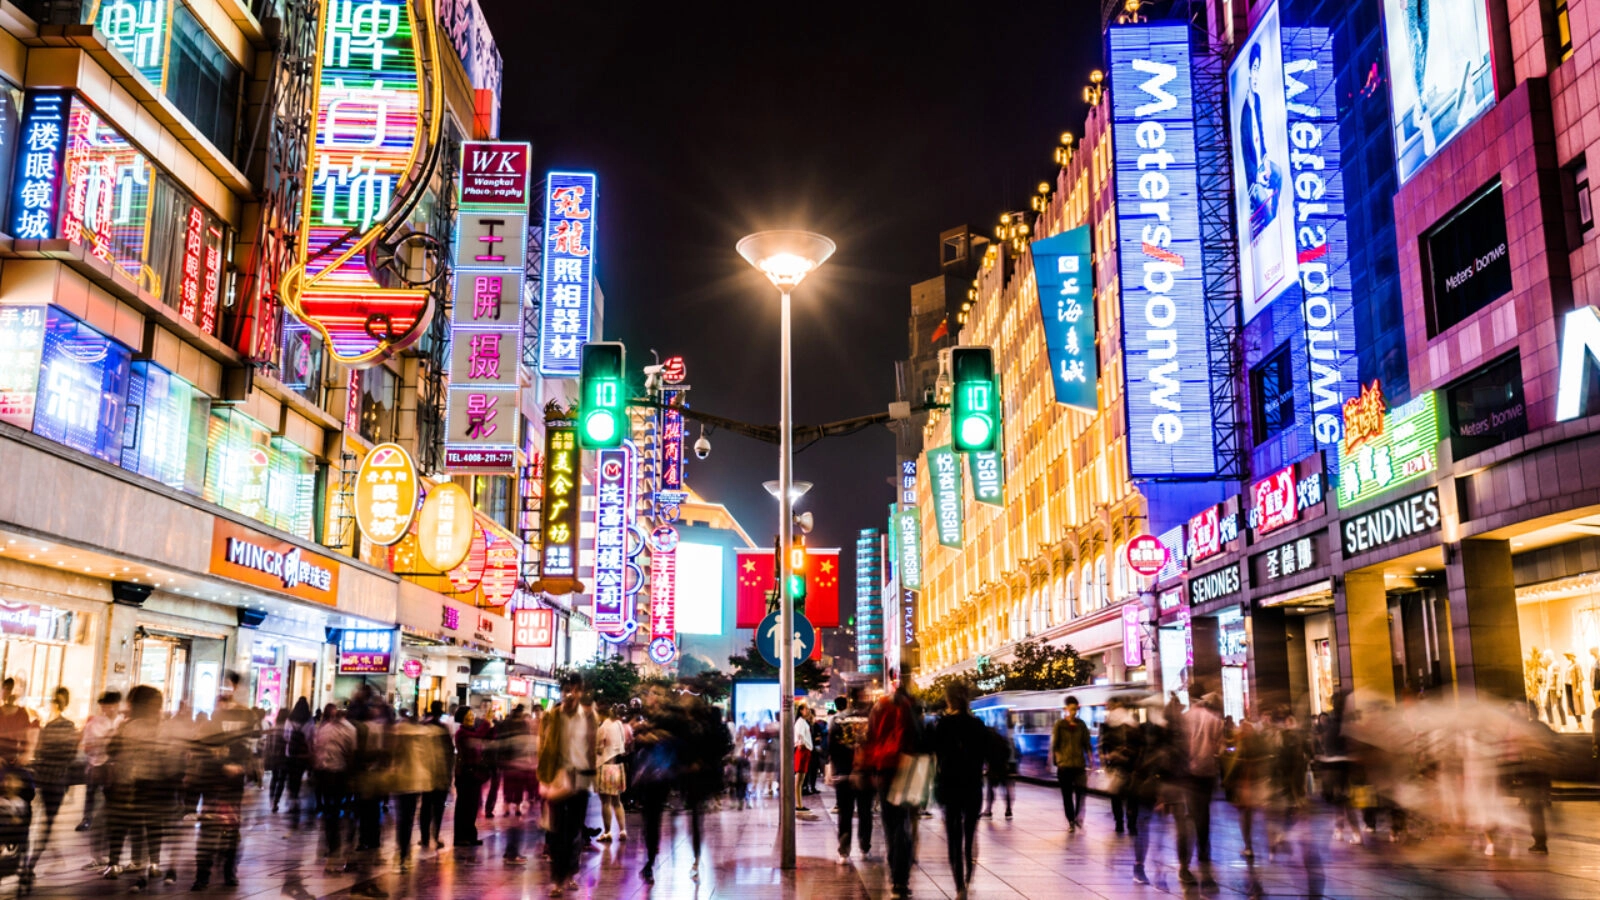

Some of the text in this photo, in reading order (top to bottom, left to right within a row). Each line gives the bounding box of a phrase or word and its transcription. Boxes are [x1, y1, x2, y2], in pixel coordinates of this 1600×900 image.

[17, 96, 62, 239] 三楼眼镜城
[1445, 243, 1506, 293] Meters/bonwe
[596, 382, 616, 407] 10
[968, 386, 988, 411] 10
[1346, 491, 1439, 554] SENDNES
[229, 538, 283, 576] MINGR
[1192, 565, 1240, 604] SENDNES
[517, 629, 547, 643] QLO
[518, 612, 546, 627] UNI
